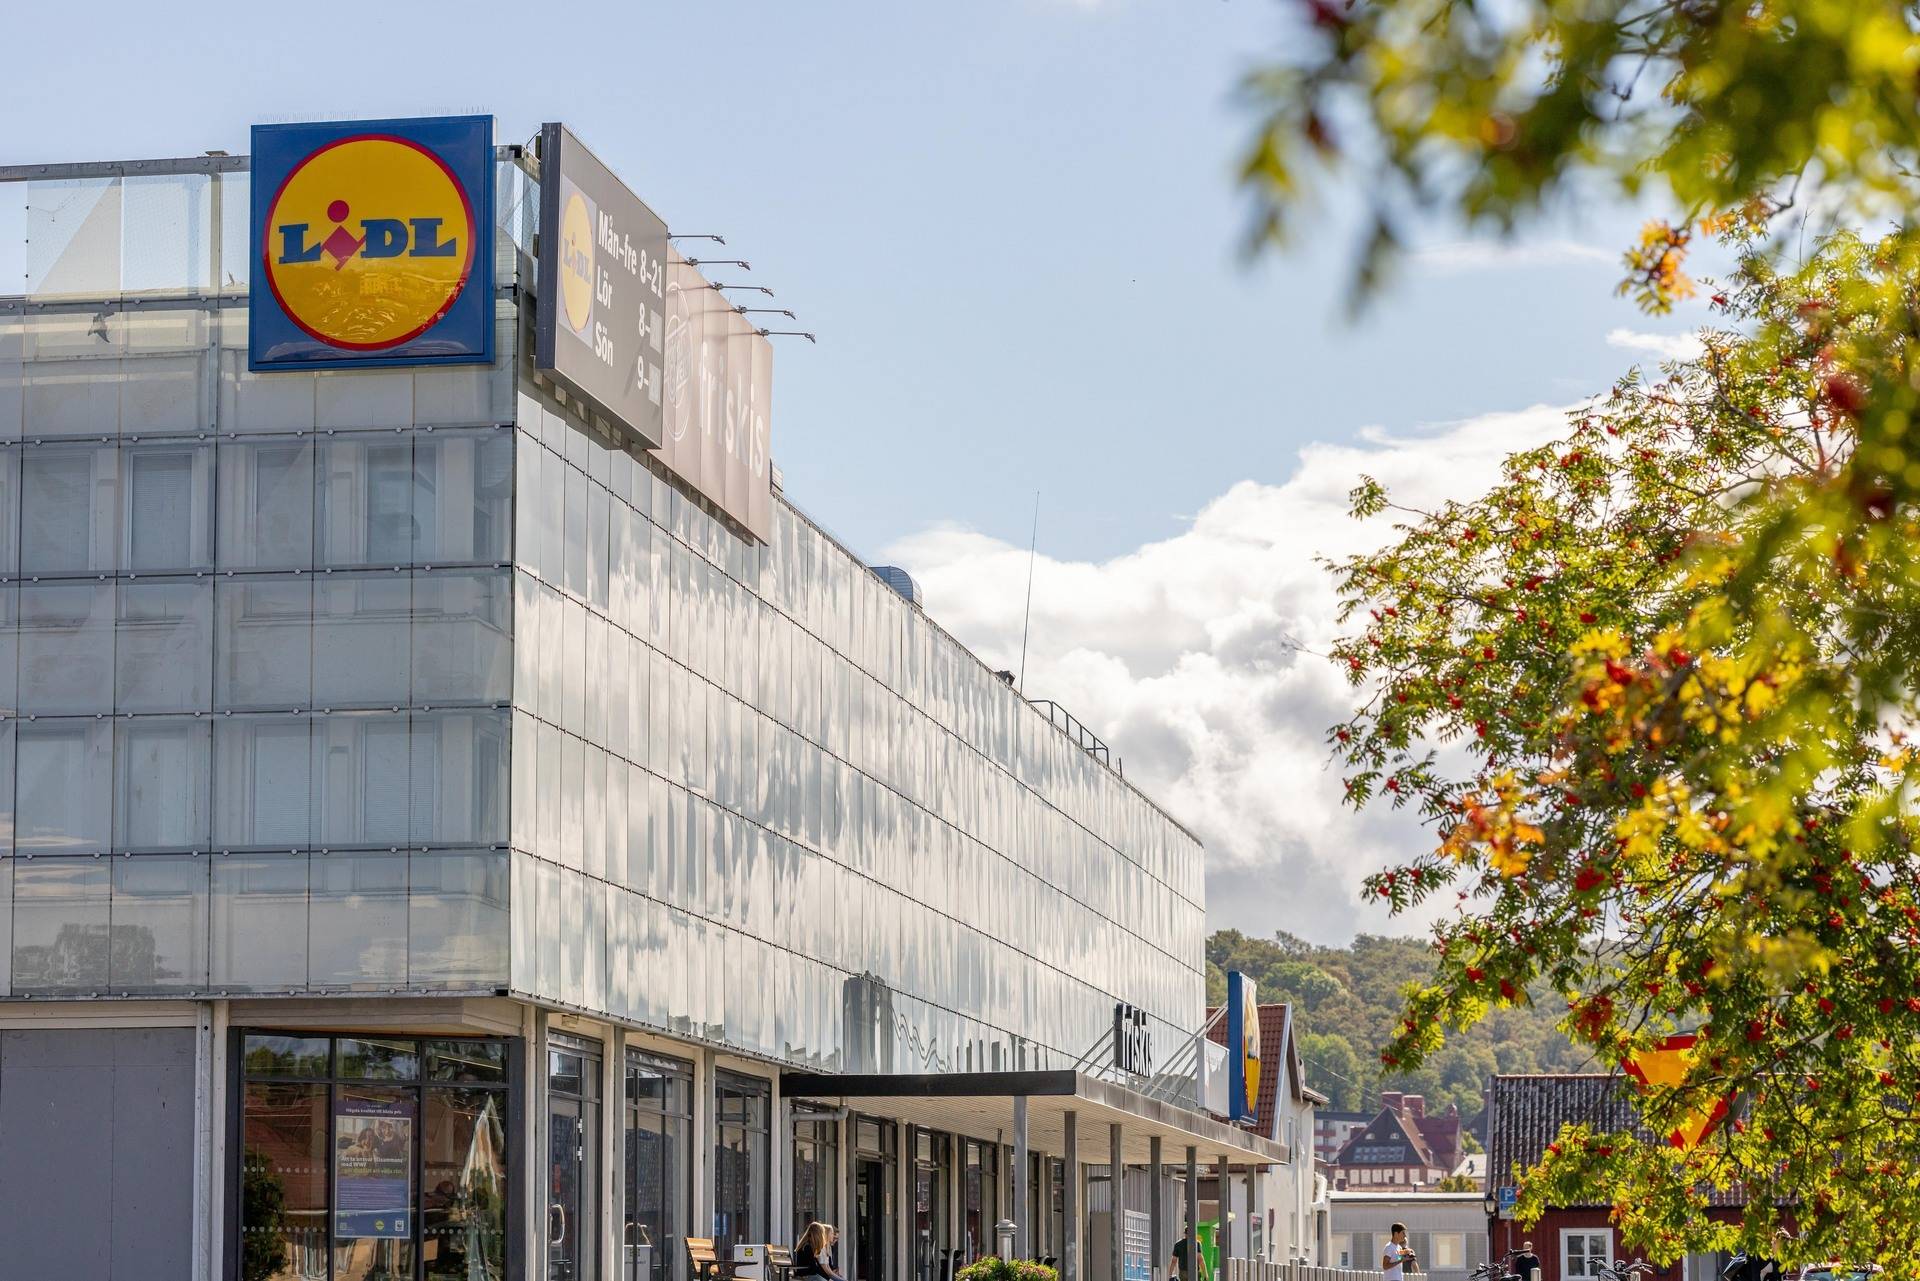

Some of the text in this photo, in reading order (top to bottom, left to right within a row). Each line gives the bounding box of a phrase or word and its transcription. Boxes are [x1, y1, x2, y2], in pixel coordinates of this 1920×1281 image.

[598, 210, 662, 298] Mån-fre 8-21
[596, 265, 612, 309] Lör
[595, 321, 613, 367] Sön
[699, 341, 764, 478] friskis
[1505, 1189, 1513, 1200] P
